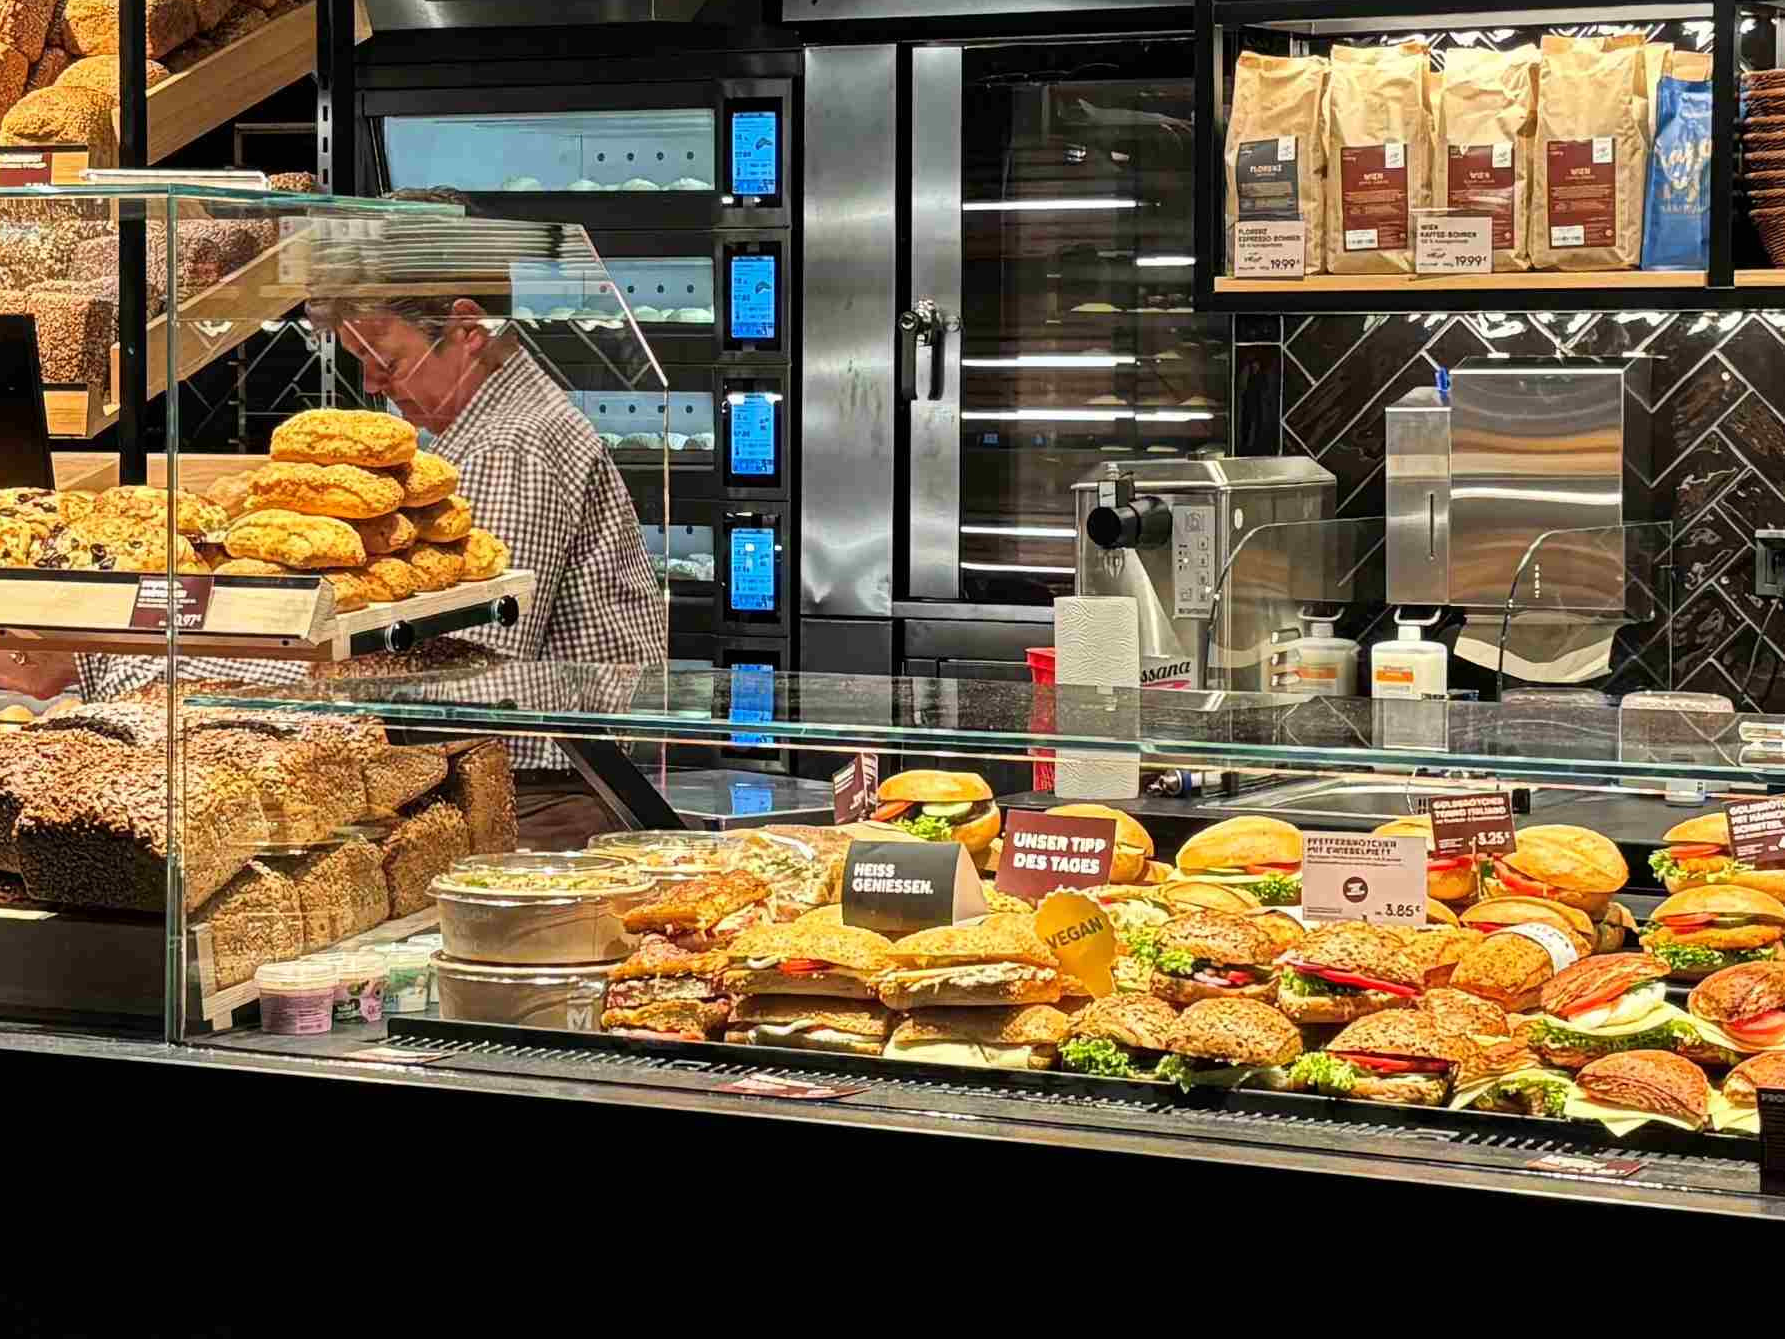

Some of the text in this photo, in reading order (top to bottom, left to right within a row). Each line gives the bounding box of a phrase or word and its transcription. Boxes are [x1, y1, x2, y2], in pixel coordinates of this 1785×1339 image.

[1139, 660, 1191, 683] ssana
[1013, 832, 1106, 854] UNSER TIPP
[854, 862, 895, 877] HEISS
[1013, 853, 1100, 875] DES TAGES
[852, 878, 934, 895] GENIESSEN.
[1045, 917, 1103, 949] VEGAN
